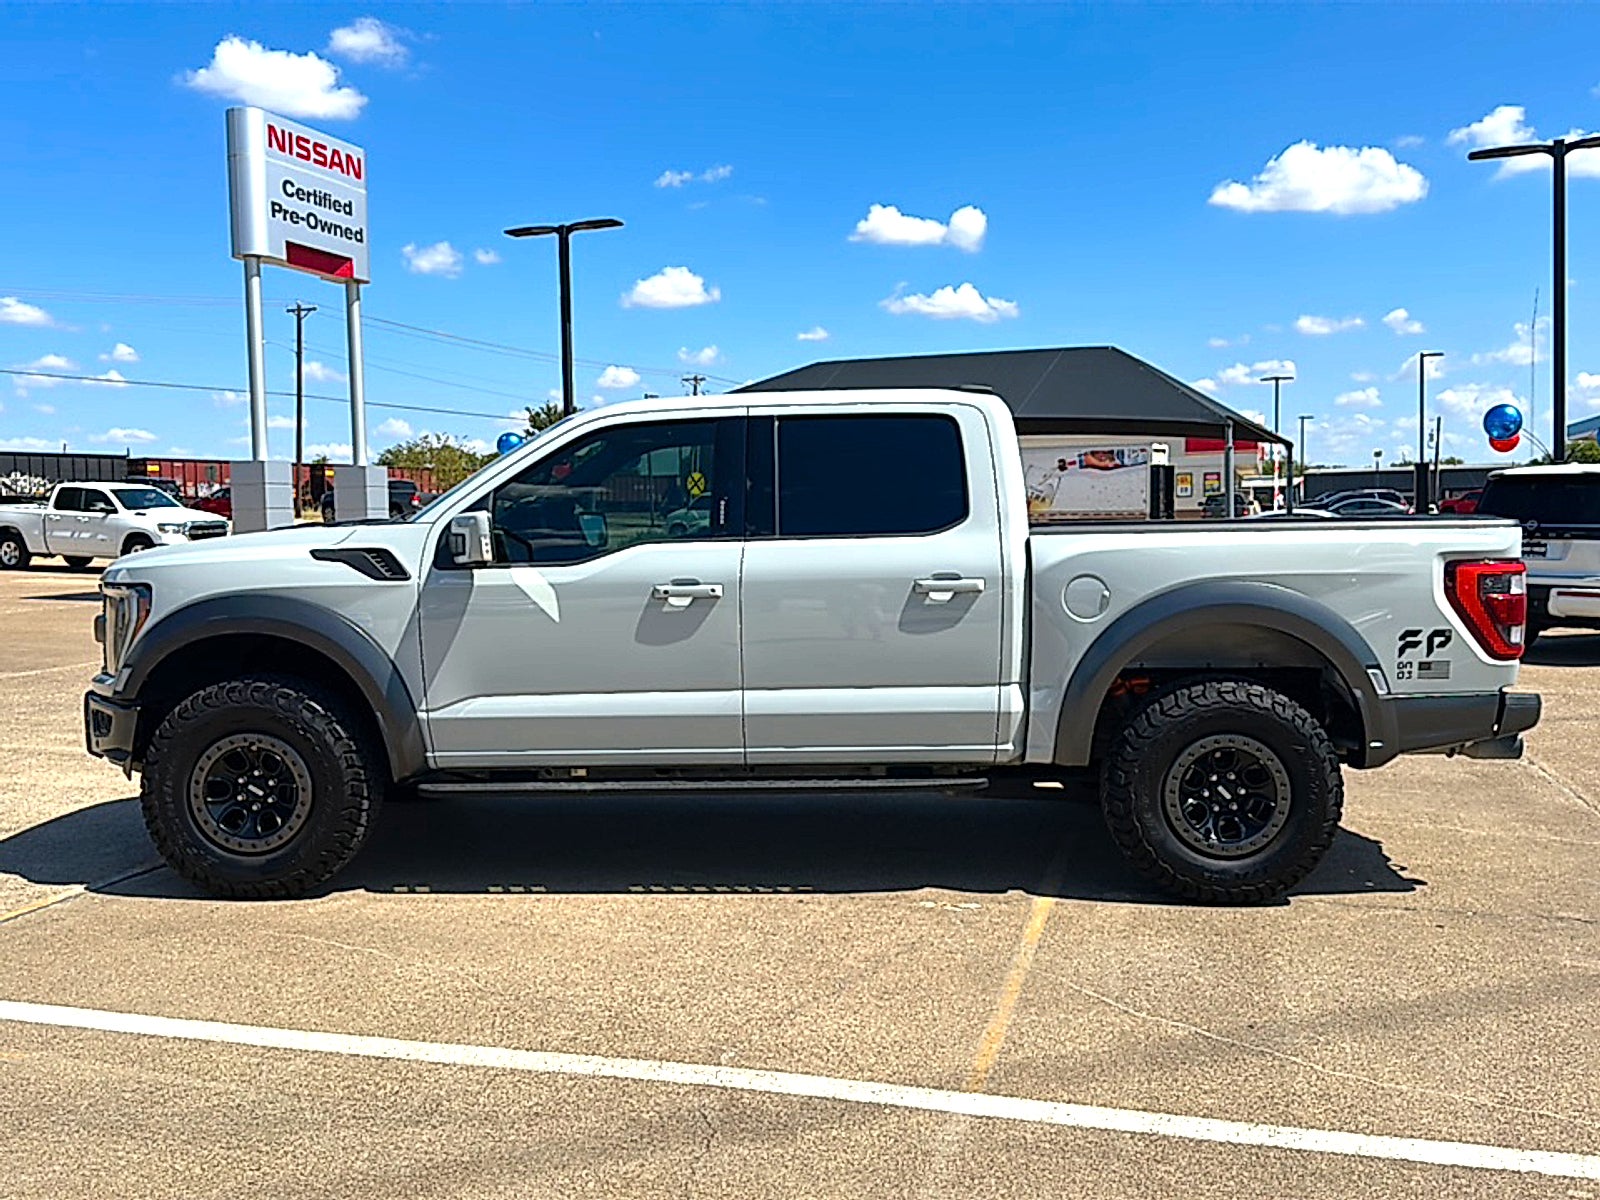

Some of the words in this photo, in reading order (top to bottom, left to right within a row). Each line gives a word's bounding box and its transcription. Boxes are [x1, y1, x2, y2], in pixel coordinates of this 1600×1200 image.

[267, 124, 362, 180] NISSAN
[282, 179, 353, 216] Certified
[270, 201, 364, 243] Pre-Owned
[1398, 629, 1453, 658] FP
